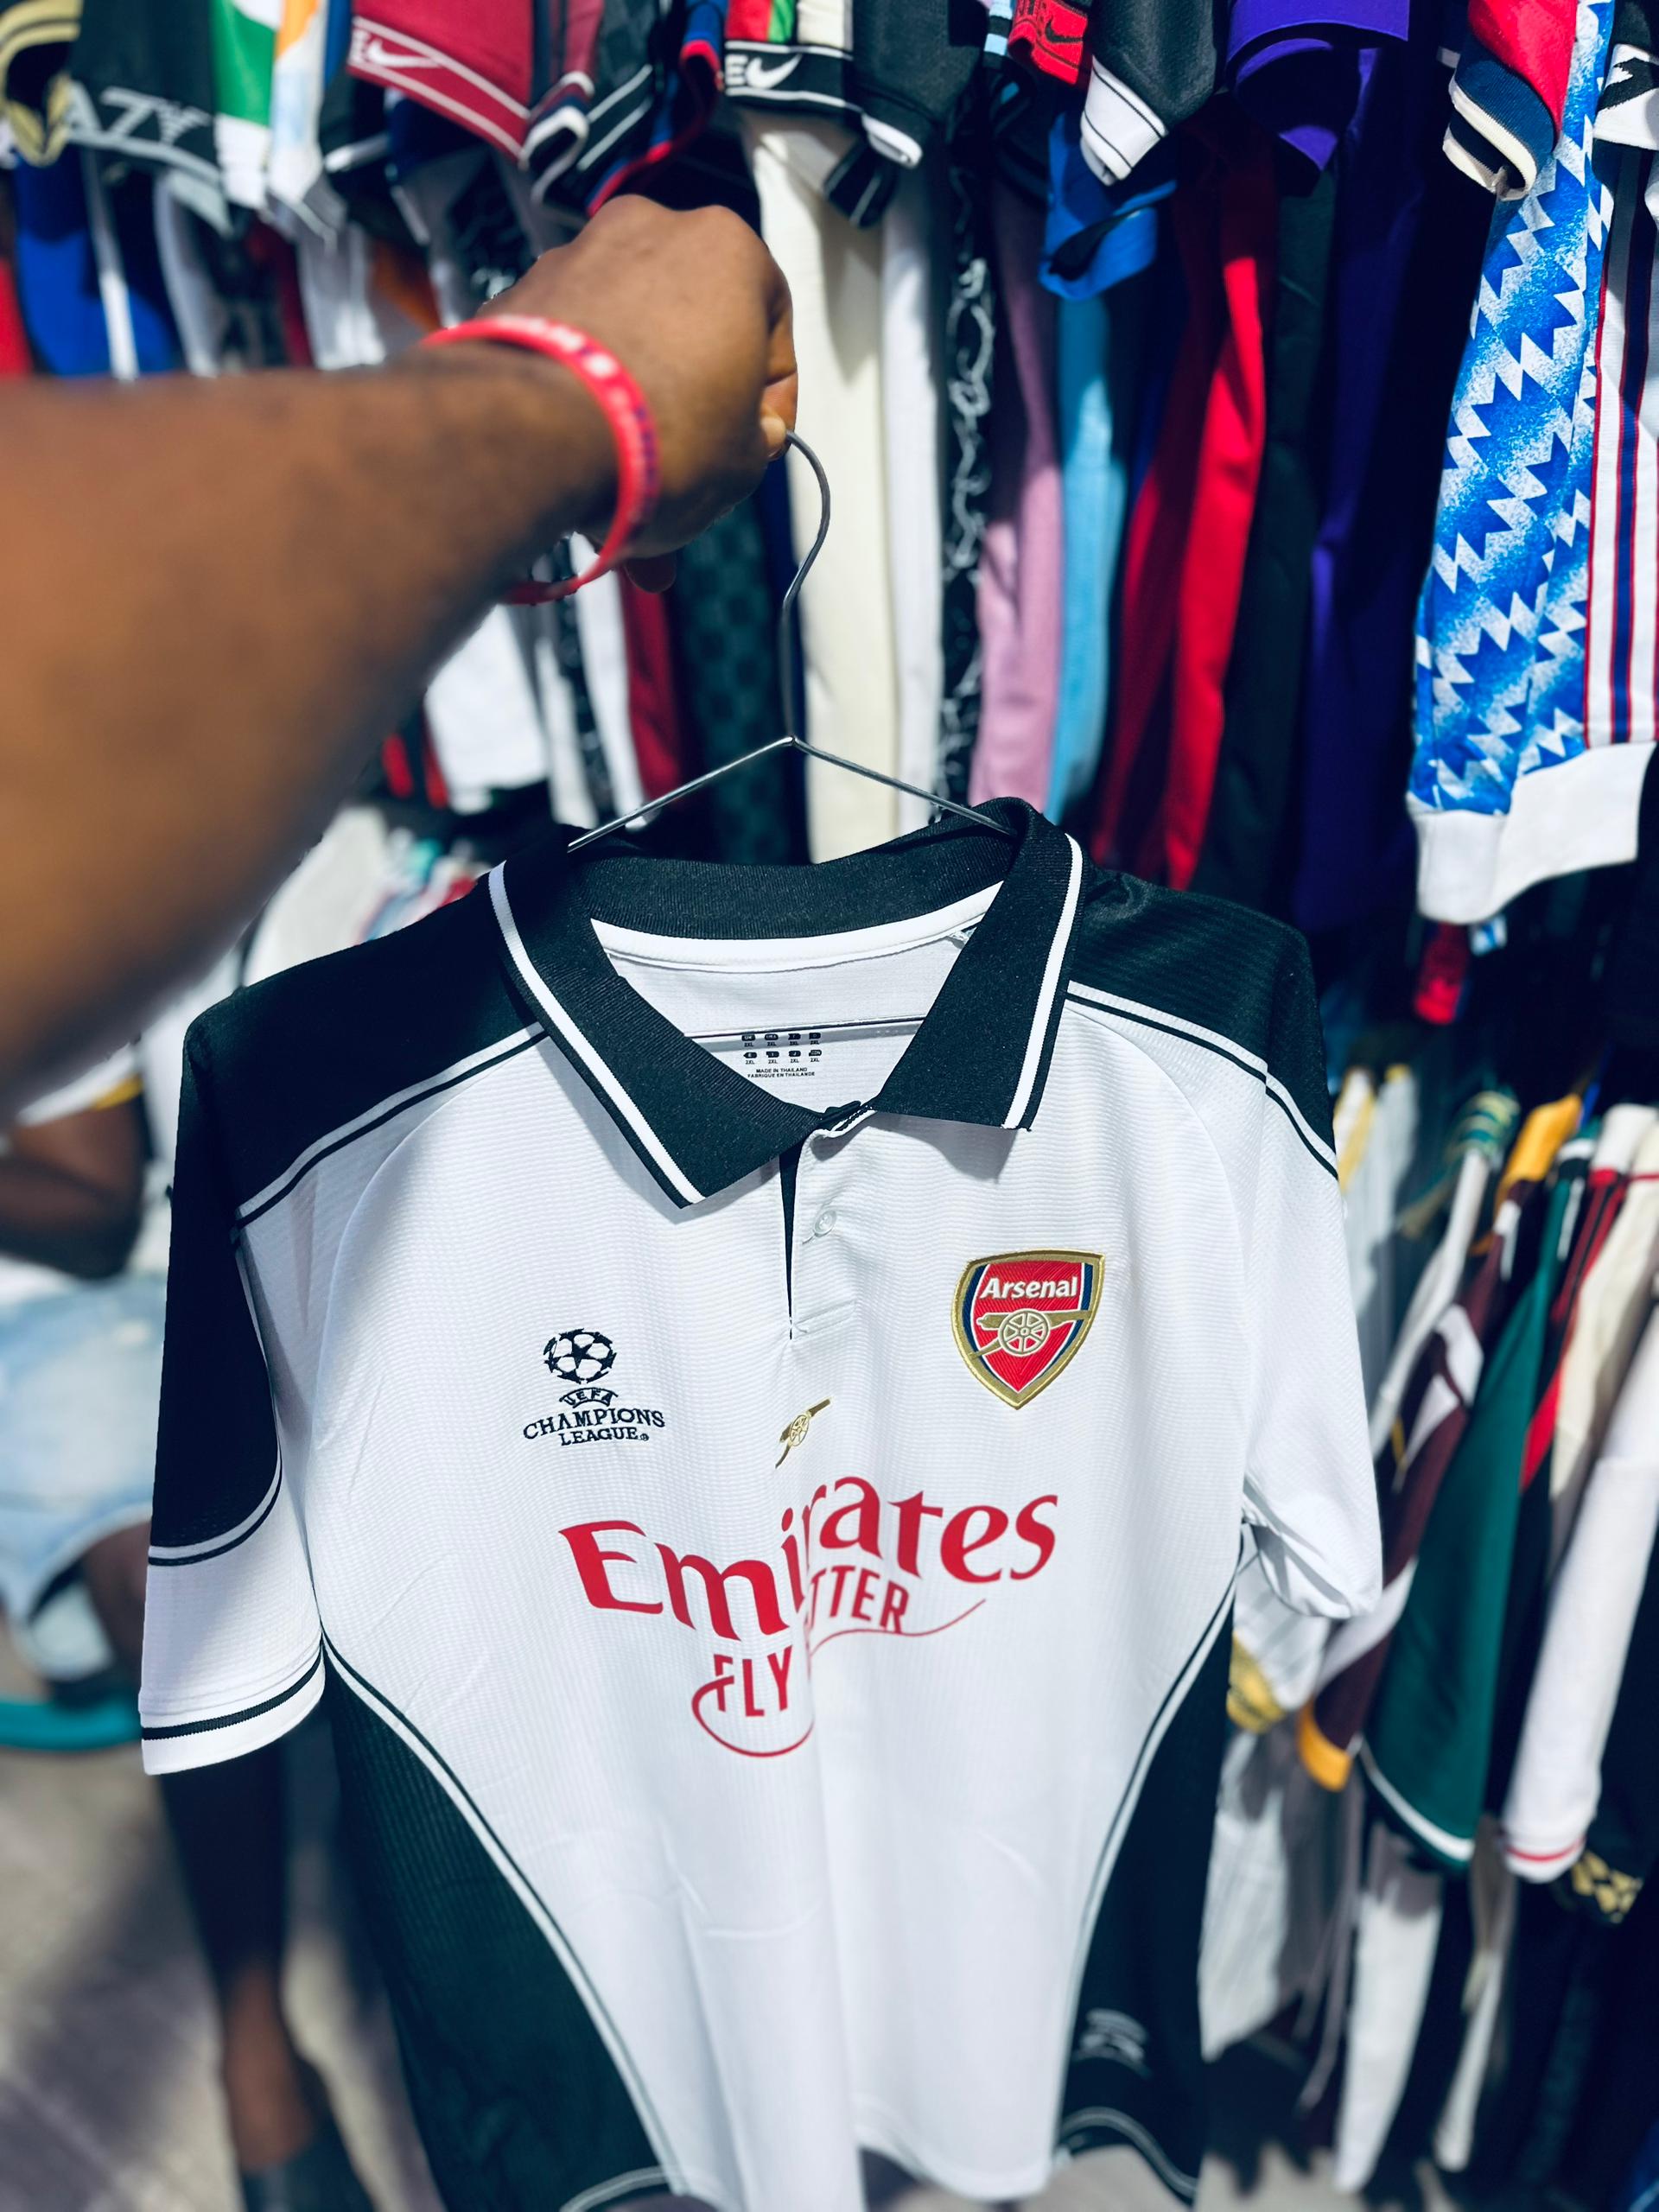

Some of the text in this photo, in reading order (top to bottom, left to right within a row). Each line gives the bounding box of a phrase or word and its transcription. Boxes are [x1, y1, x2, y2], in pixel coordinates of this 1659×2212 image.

[979, 1275, 1078, 1300] Arsenal
[563, 1388, 614, 1408] UEFA
[523, 1408, 665, 1440] CHAMPIONS
[558, 1476, 1058, 1642] Emirates
[714, 1565, 910, 1717] FLY TTER
